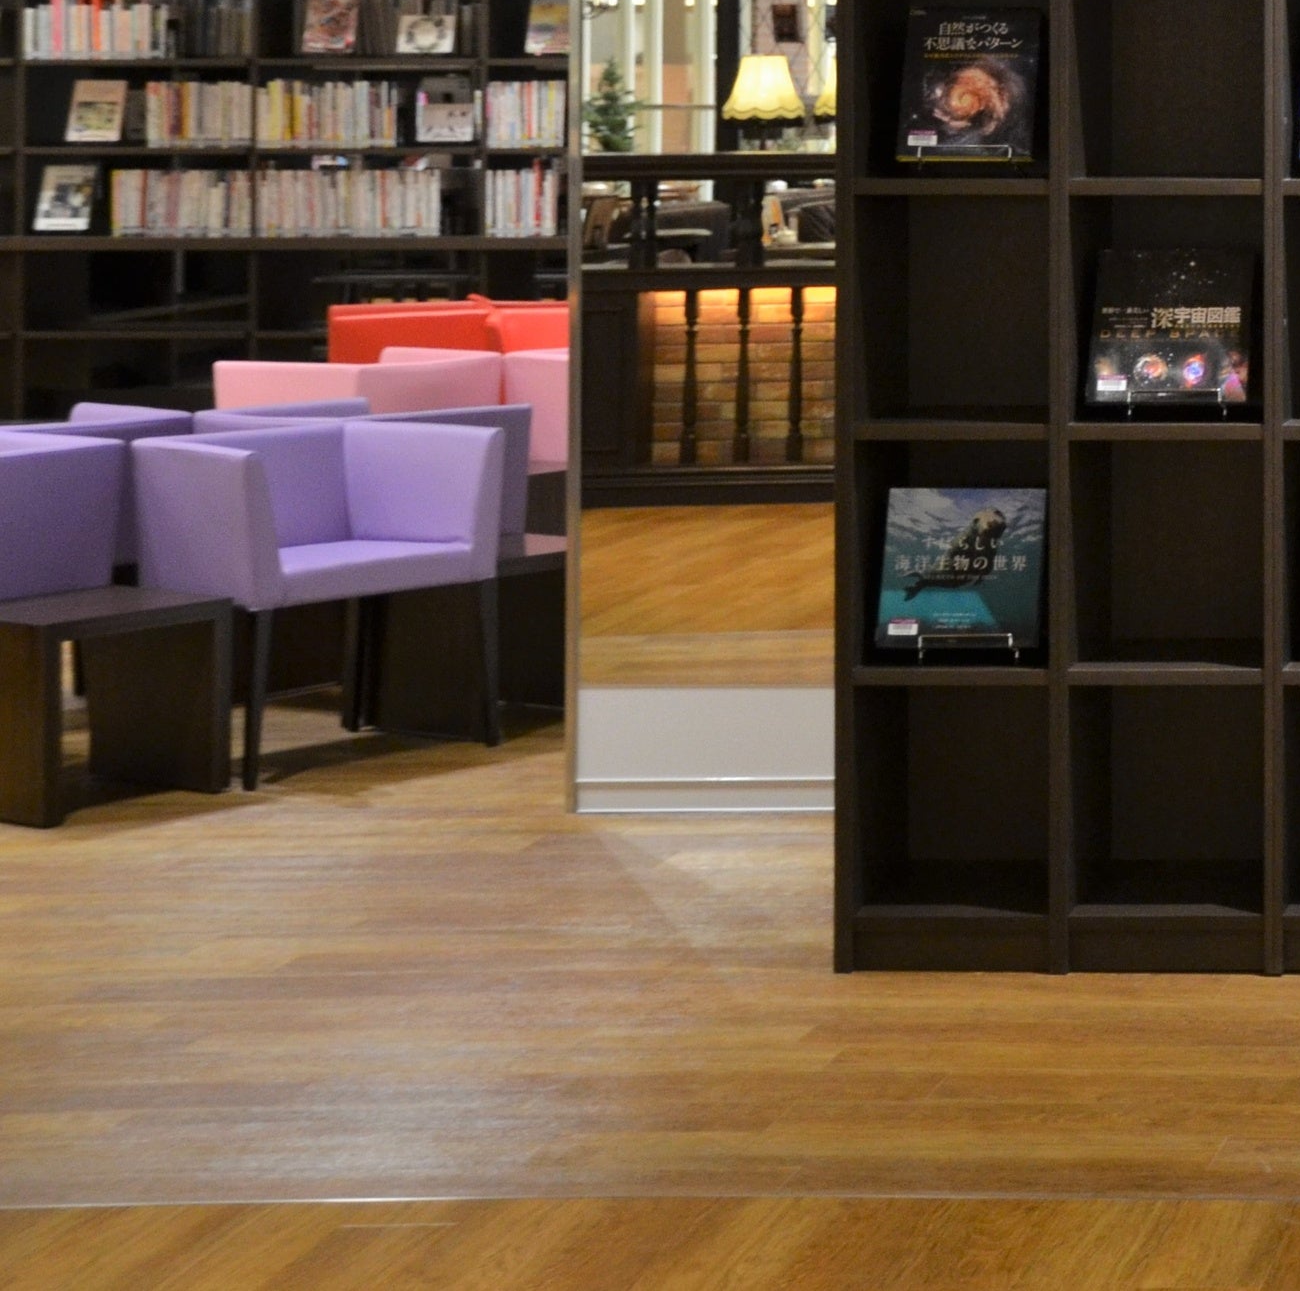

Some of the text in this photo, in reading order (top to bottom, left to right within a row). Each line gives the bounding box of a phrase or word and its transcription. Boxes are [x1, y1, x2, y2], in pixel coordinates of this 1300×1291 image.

[938, 22, 1009, 36] 自然がつくる
[923, 36, 1024, 51] 不思議なパターン
[1151, 307, 1241, 328] 深宇宙図鑑
[894, 555, 1028, 572] 海洋生物の世界
